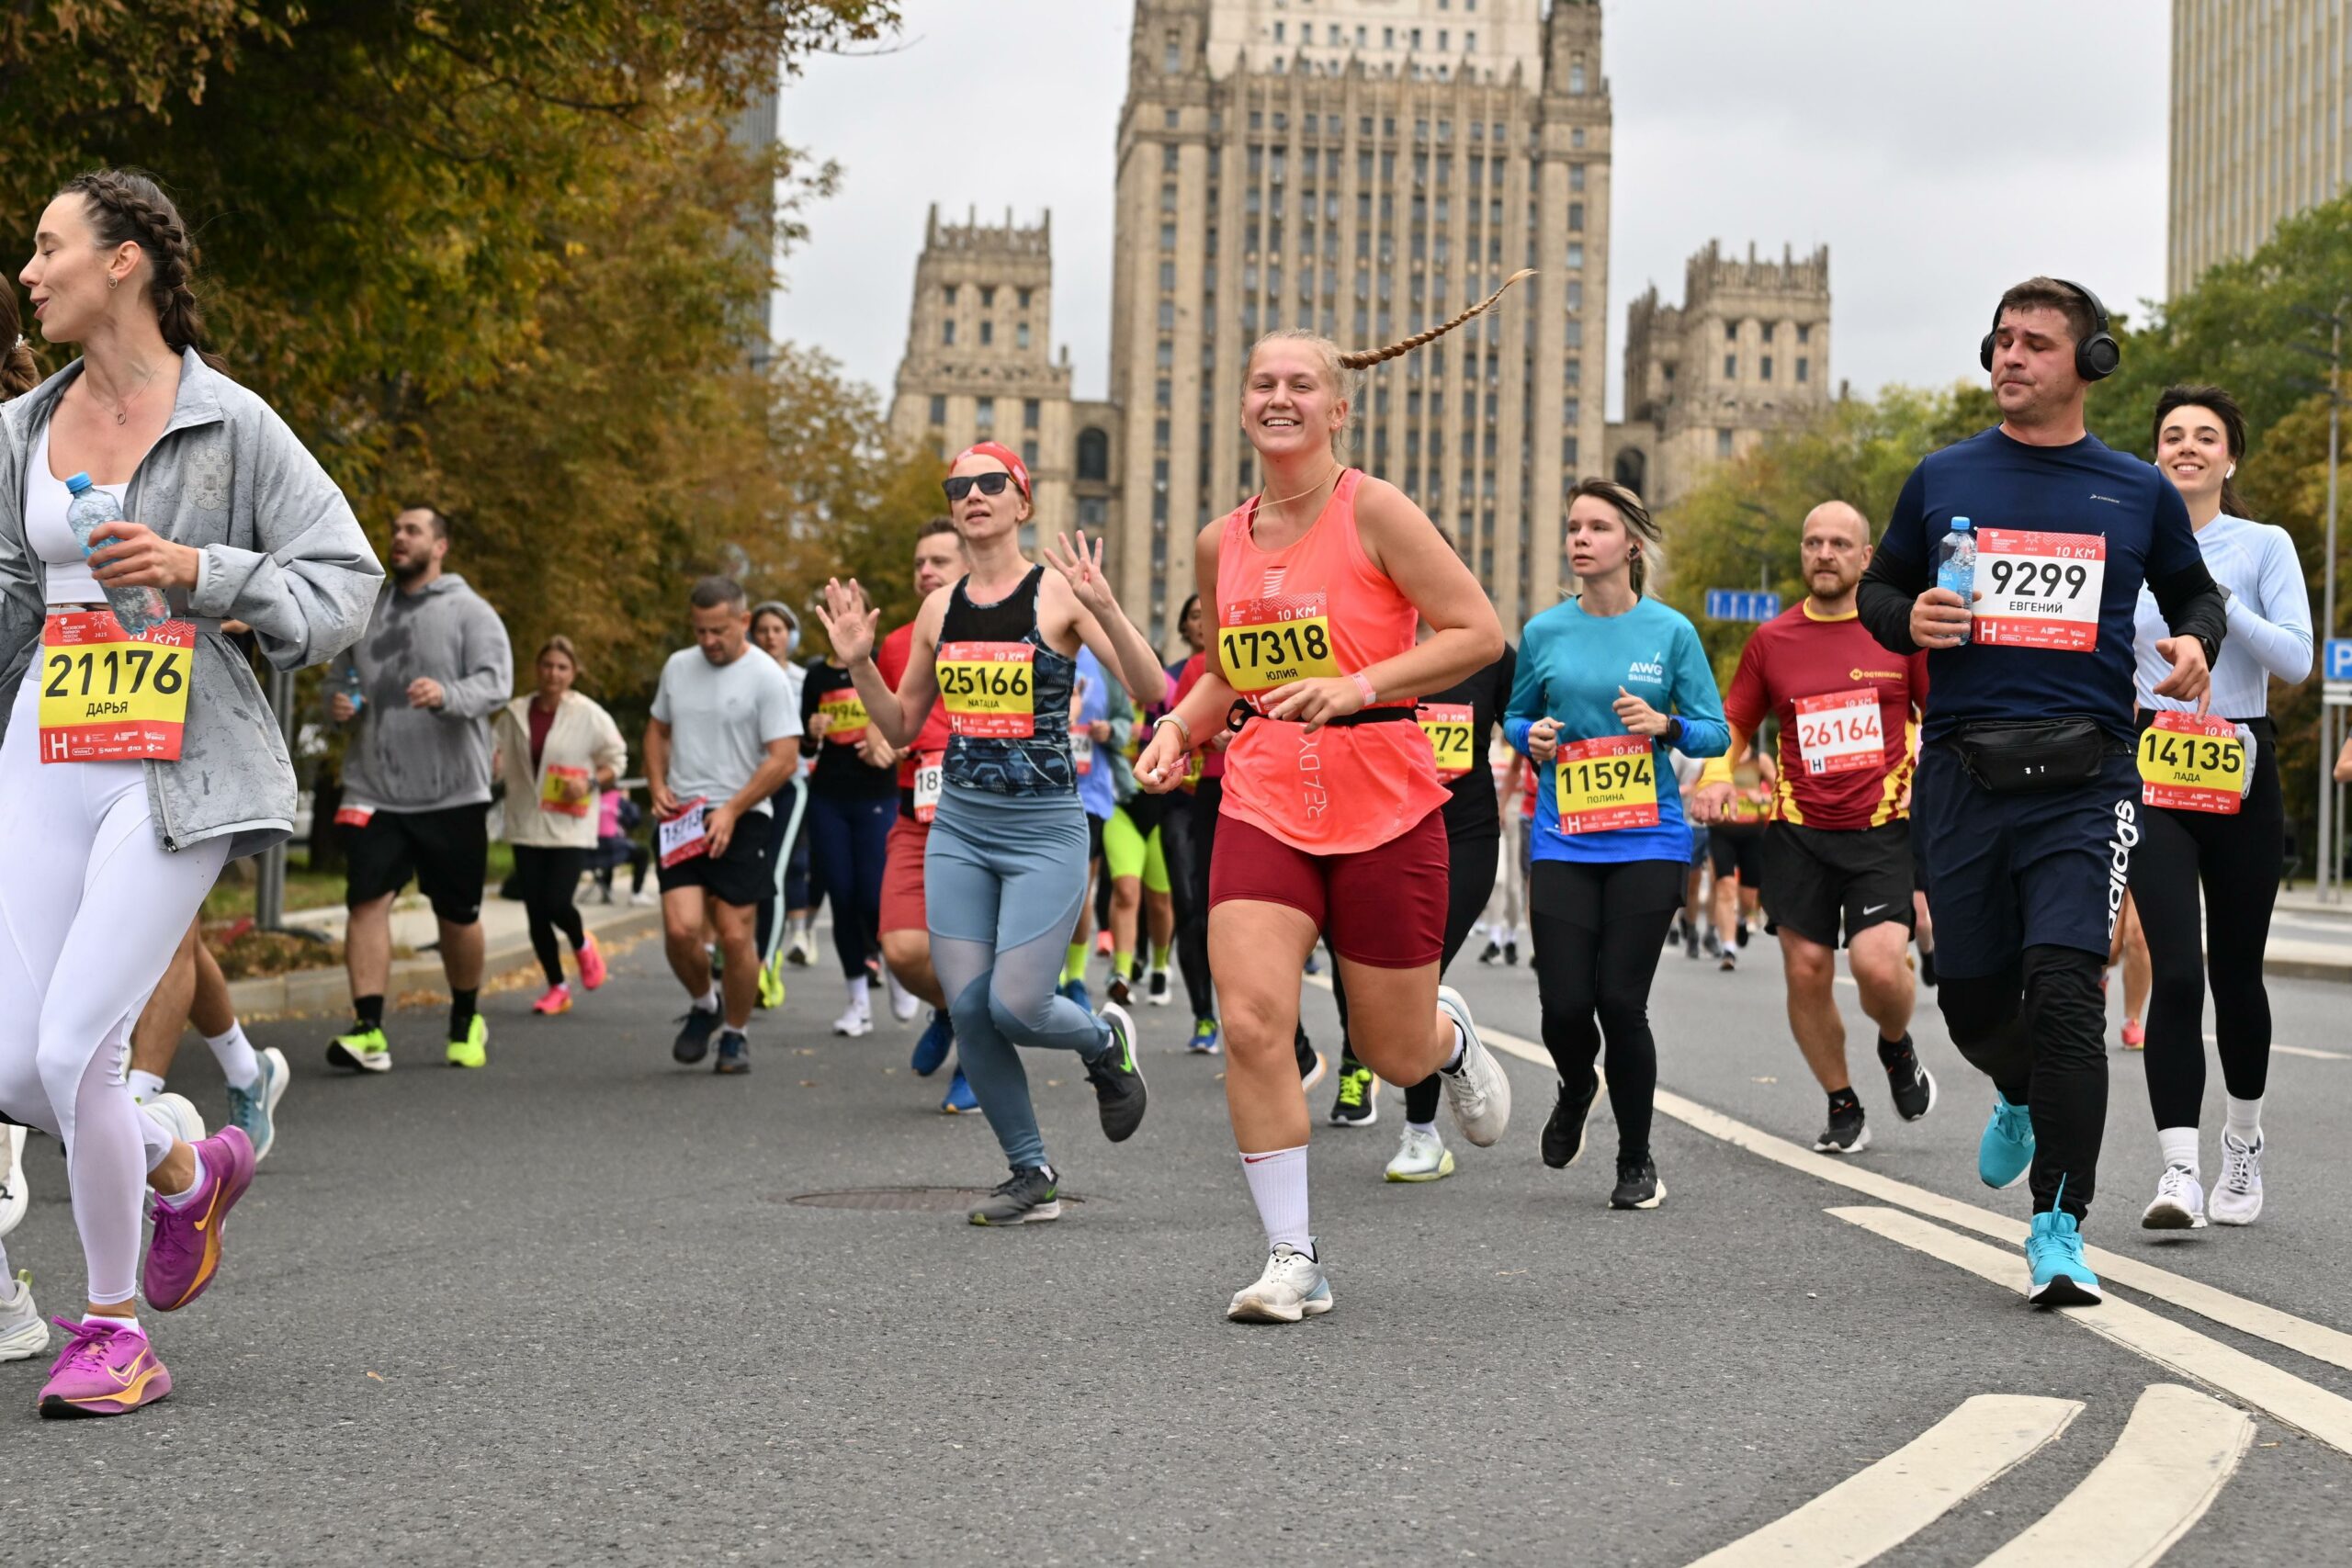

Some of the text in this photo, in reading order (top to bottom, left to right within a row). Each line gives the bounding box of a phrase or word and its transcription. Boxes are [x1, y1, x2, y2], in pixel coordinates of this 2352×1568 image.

[2055, 546, 2096, 559] 10 KM
[1992, 560, 2086, 600] 9299
[1276, 605, 1317, 622] 10 KM
[2009, 601, 2063, 614] ЕВГЕНИЙ
[153, 634, 181, 646] KM
[1981, 621, 1997, 642] H
[1224, 624, 1328, 669] 17318
[994, 652, 1025, 662] 10 KM
[2335, 645, 2352, 676] P
[45, 649, 182, 697] 21176
[1266, 668, 1298, 681] ЮЛИЯ
[1630, 660, 1663, 676] AWG
[940, 667, 1028, 695] 25166
[86, 701, 128, 717] ДАРЬЯ
[967, 699, 1000, 708] NATALIA
[1845, 697, 1872, 708] 10 KM
[951, 715, 962, 733] H
[1436, 713, 1467, 721] 10 KM
[1425, 727, 1469, 751] 72
[1802, 715, 1880, 748] 26164
[2205, 726, 2218, 736] 10
[51, 732, 69, 760] H
[1612, 744, 1644, 756] 10 KM
[2145, 734, 2241, 773] 14135
[1812, 758, 1822, 772] H
[1298, 737, 1328, 818] READY
[1561, 759, 1652, 794] 11594
[2173, 773, 2200, 783] ЛАДА
[1587, 794, 1624, 805] ПОЛИНА
[1566, 815, 1580, 833] H
[2108, 799, 2139, 940] adidas
